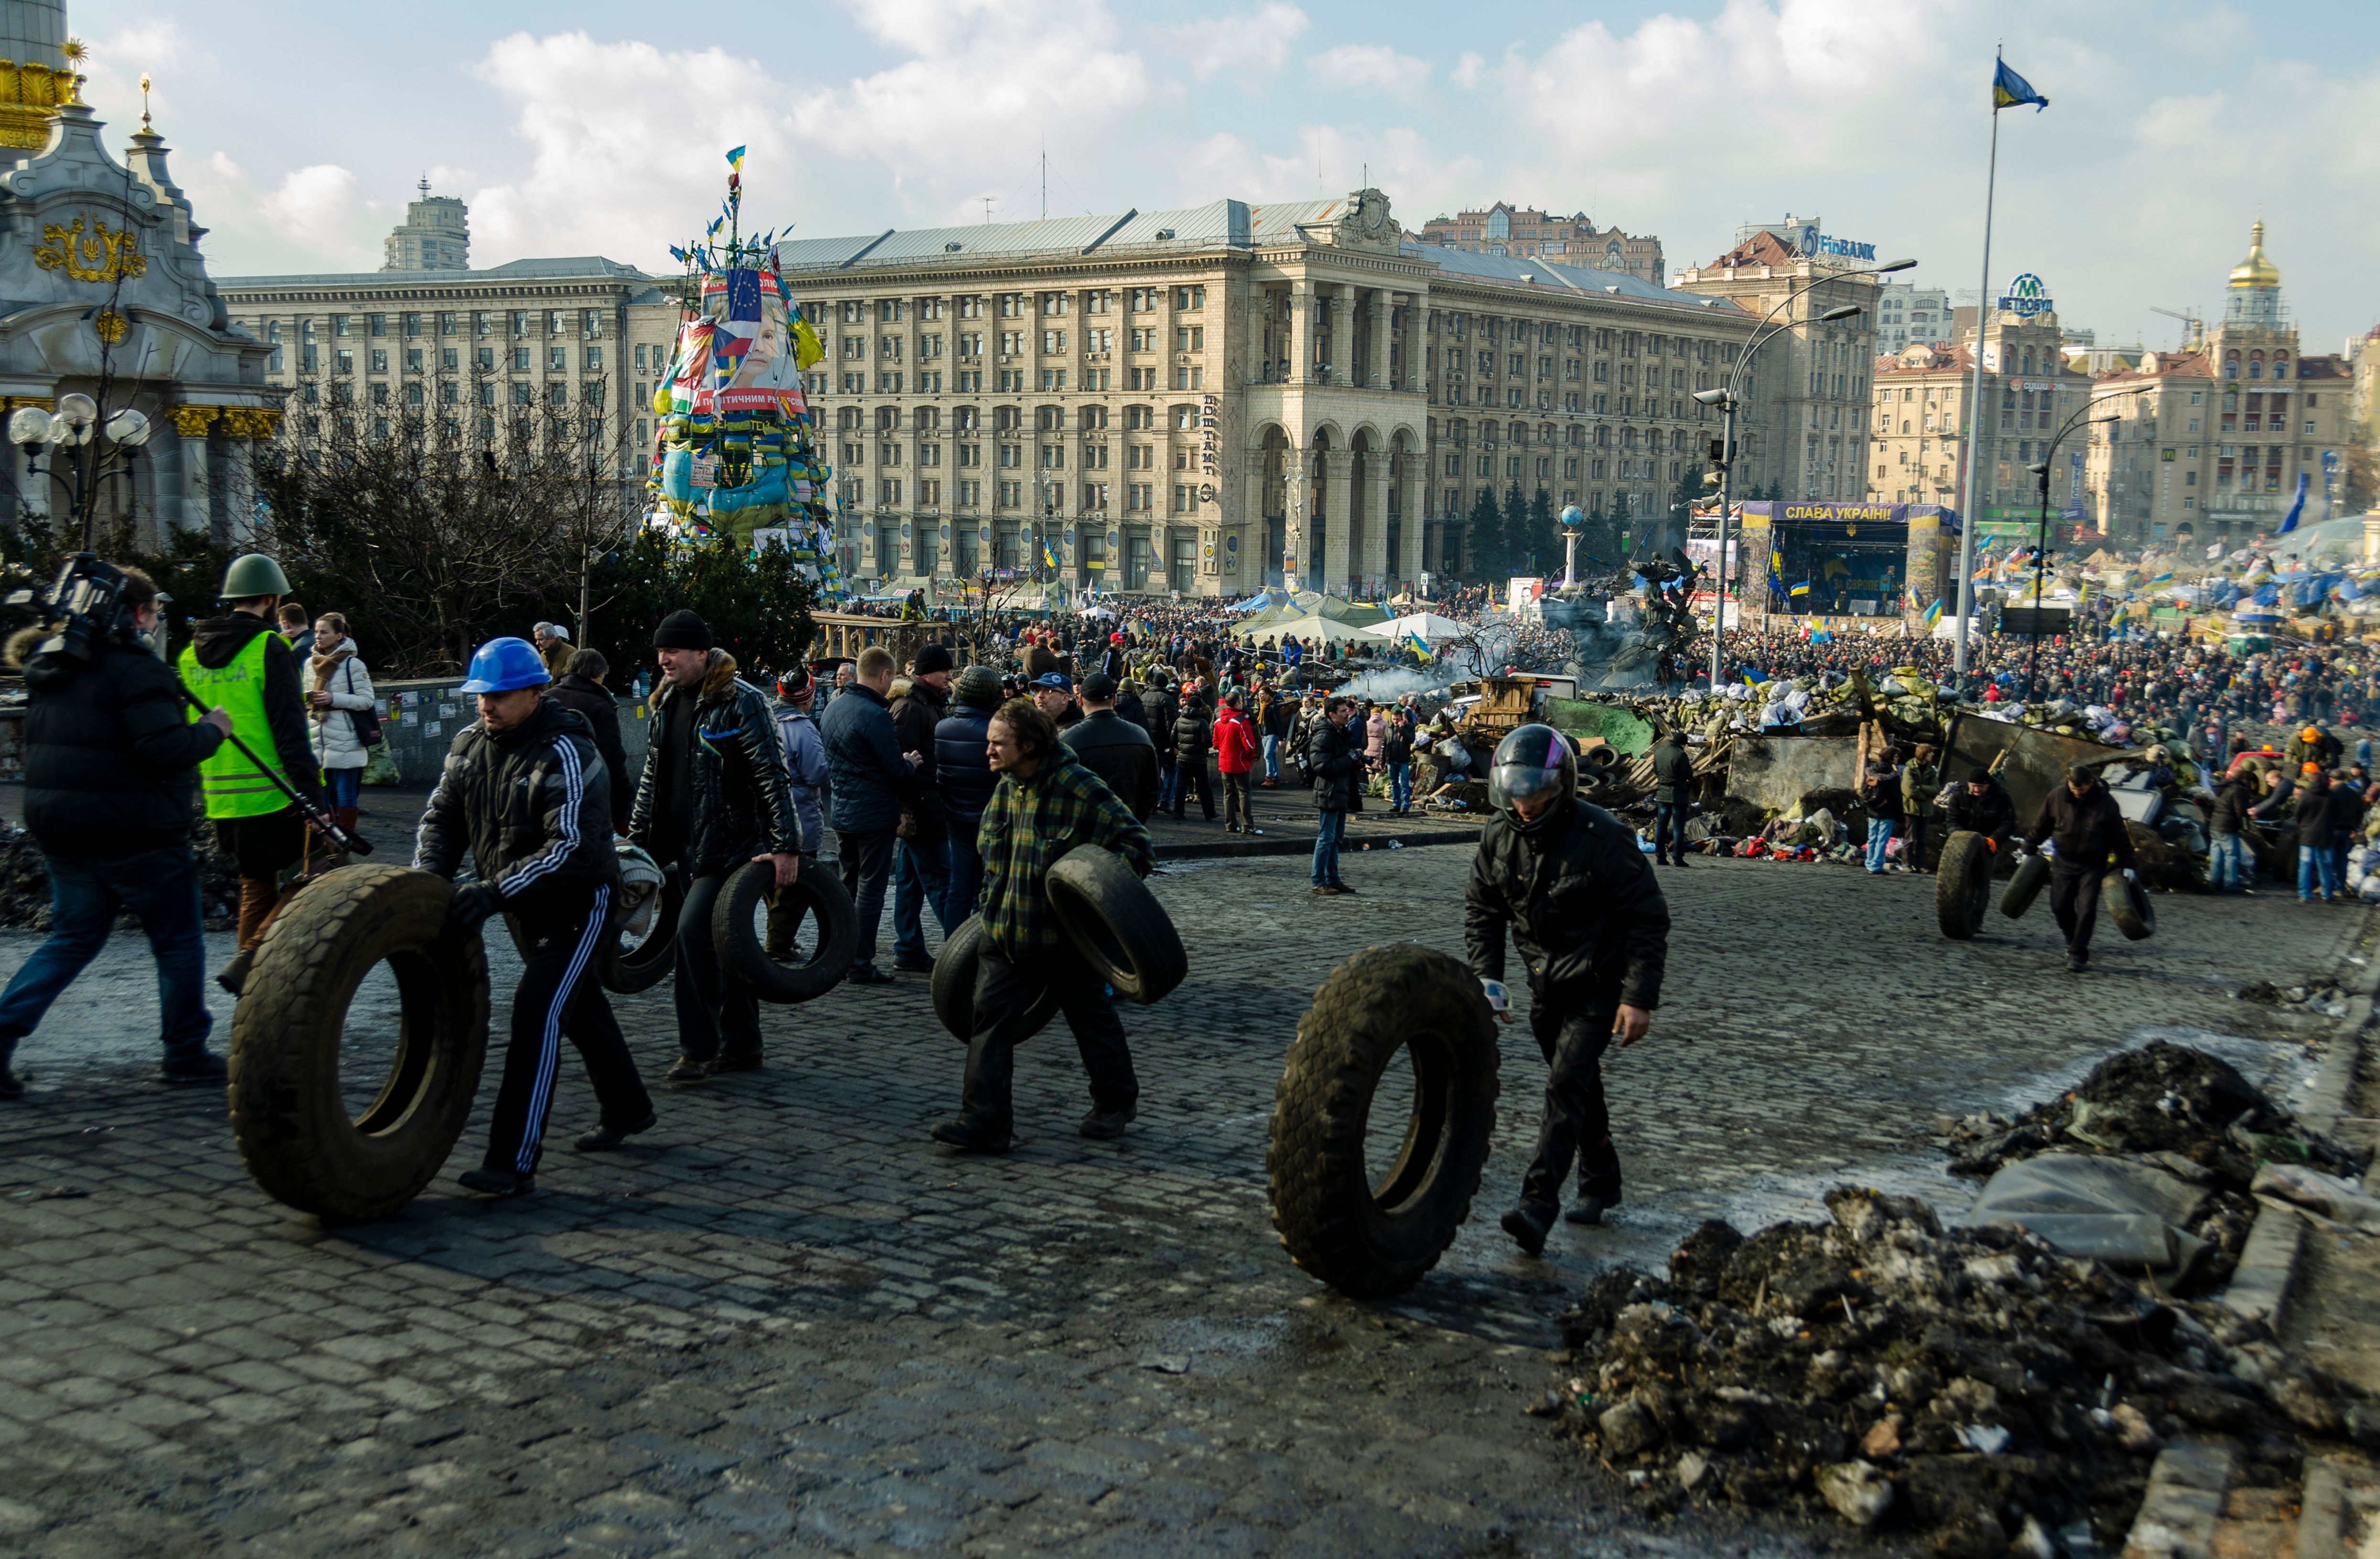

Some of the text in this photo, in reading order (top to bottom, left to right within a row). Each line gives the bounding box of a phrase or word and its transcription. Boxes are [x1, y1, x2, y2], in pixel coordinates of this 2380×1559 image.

[1820, 235, 1876, 261] FinBANK
[1996, 297, 2053, 312] МЕТРОБУД
[1203, 395, 1214, 475] ПОШТАМТ
[1786, 506, 1891, 520] СЛАВА УКРАЇНІ!
[1833, 579, 1843, 589] ЗА
[189, 662, 249, 685] ПРЕСА
